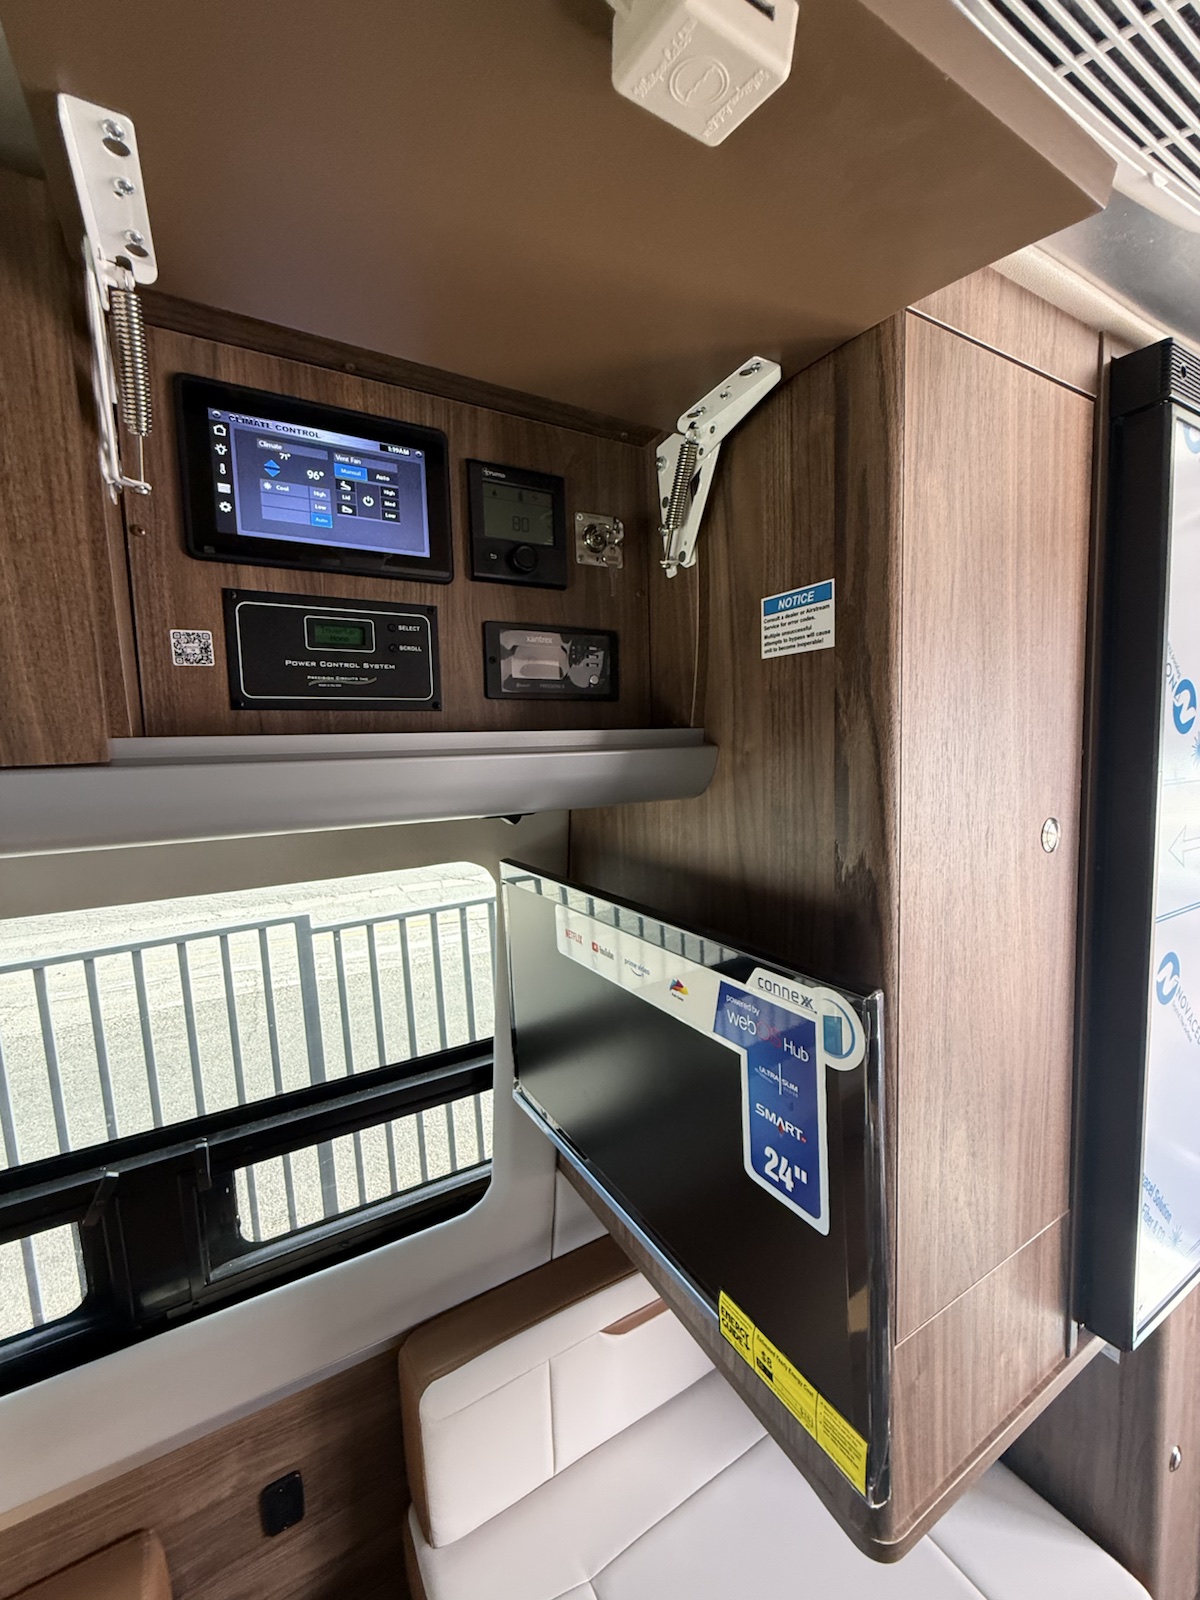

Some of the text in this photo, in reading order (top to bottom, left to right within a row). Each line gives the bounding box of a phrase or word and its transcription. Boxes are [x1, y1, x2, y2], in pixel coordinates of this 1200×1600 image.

[229, 413, 321, 438] CLIMATE CONTROL
[258, 439, 283, 450] Climate
[335, 454, 361, 465] Vent Fan
[340, 467, 362, 476] Manual
[375, 474, 390, 482] Auto
[275, 484, 290, 492] Cool
[313, 490, 326, 498] High
[383, 489, 396, 497] High
[778, 590, 815, 610] NOTICE
[763, 616, 780, 624] Consult
[785, 611, 799, 619] dealer
[806, 604, 830, 613] Airstream
[781, 625, 813, 636] unsuccessful
[526, 635, 553, 644] xantrex
[764, 639, 783, 647] attempts
[789, 635, 806, 643] bypass
[816, 629, 831, 637] cause
[399, 644, 422, 652] SCROLL
[778, 643, 796, 652] become
[565, 928, 583, 945] NETFLIX
[624, 958, 637, 970] prime
[726, 994, 760, 1016] powered by
[783, 1037, 810, 1062] Hub
[758, 1065, 779, 1082] ULTRA
[781, 1078, 799, 1093] SLIM
[755, 1102, 803, 1141] SMART
[764, 1145, 807, 1192] 24"
[1153, 1188, 1172, 1224] Solution
[788, 1367, 803, 1387] Energy
